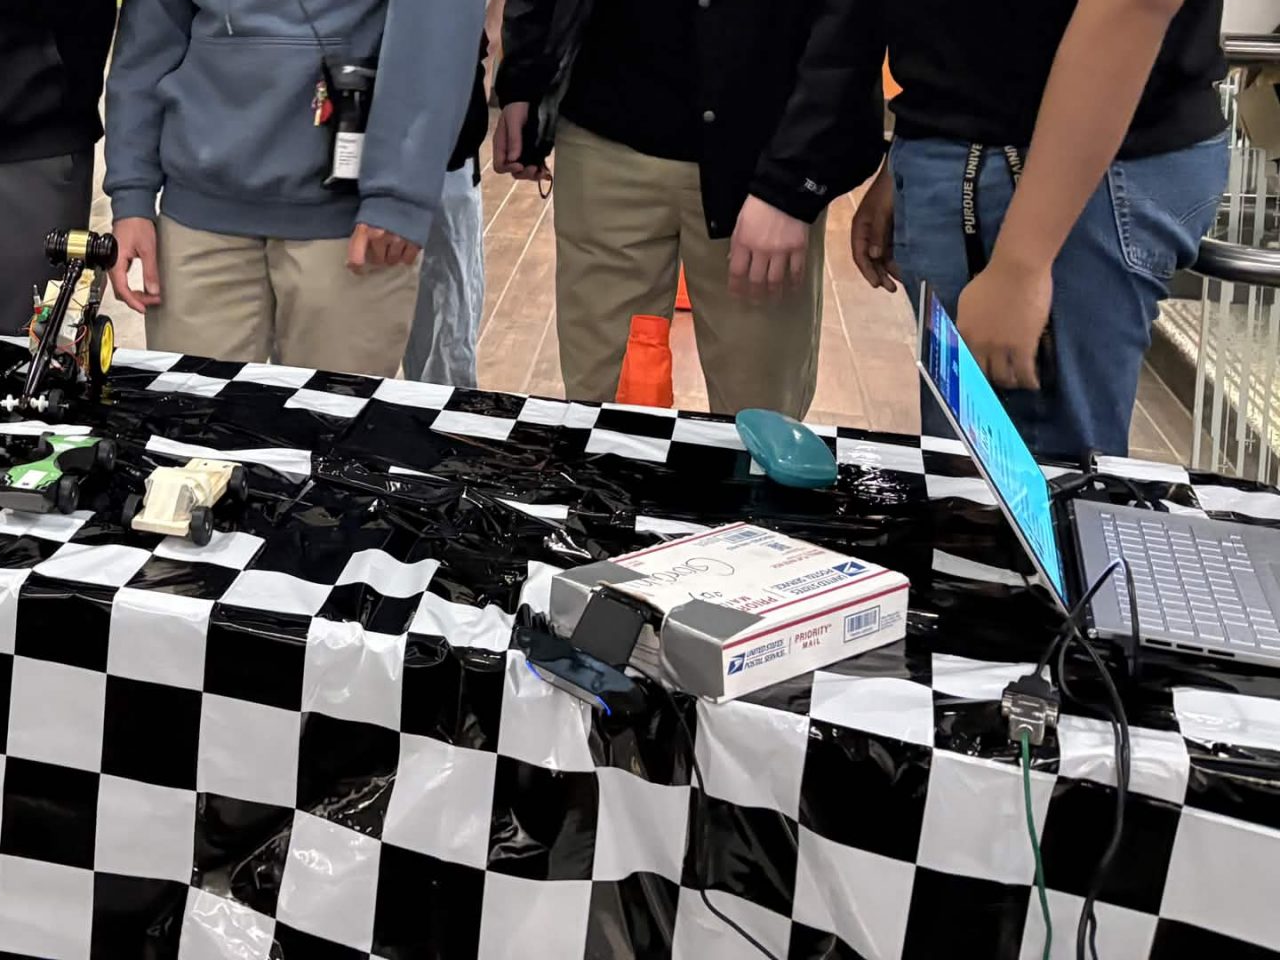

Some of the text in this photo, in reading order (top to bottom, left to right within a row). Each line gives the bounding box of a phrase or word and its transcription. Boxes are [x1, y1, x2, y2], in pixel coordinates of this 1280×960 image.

[962, 181, 976, 234] PURDUE
[737, 596, 777, 612] PRIOR
[795, 624, 829, 642] PRIORITY
[746, 644, 765, 657] UNITED
[802, 640, 821, 650] MAIL
